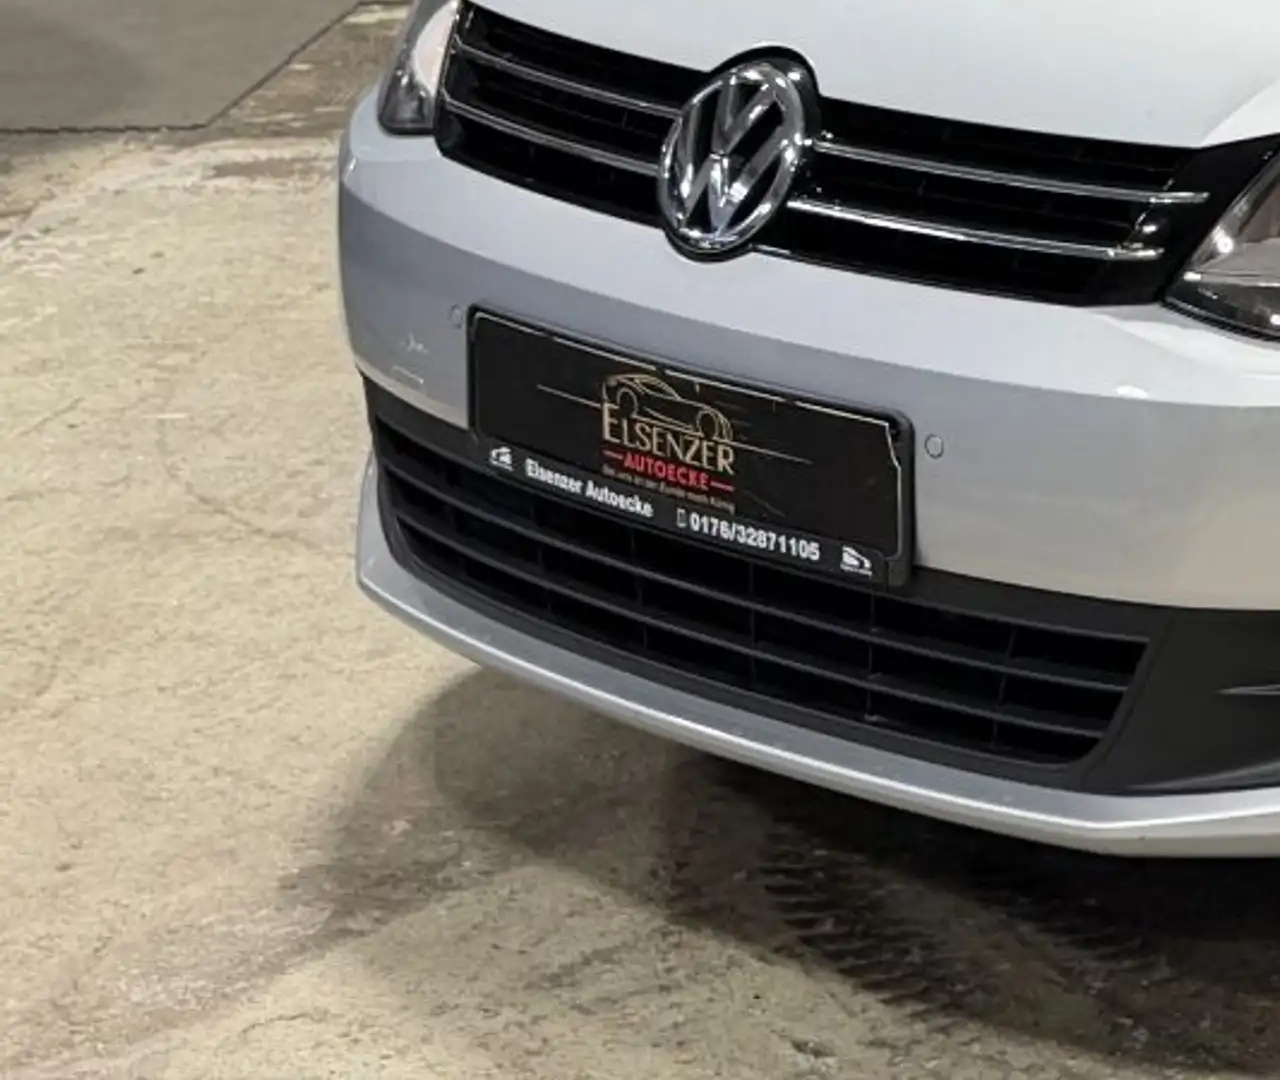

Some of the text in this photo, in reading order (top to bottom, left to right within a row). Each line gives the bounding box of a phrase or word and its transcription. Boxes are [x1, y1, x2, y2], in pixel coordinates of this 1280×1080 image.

[602, 402, 735, 475] ELSENZER
[623, 452, 709, 490] AUTOECKE
[525, 457, 583, 495] Elsenzer
[585, 480, 654, 517] Autoecke
[689, 513, 820, 561] 0176/32871105
